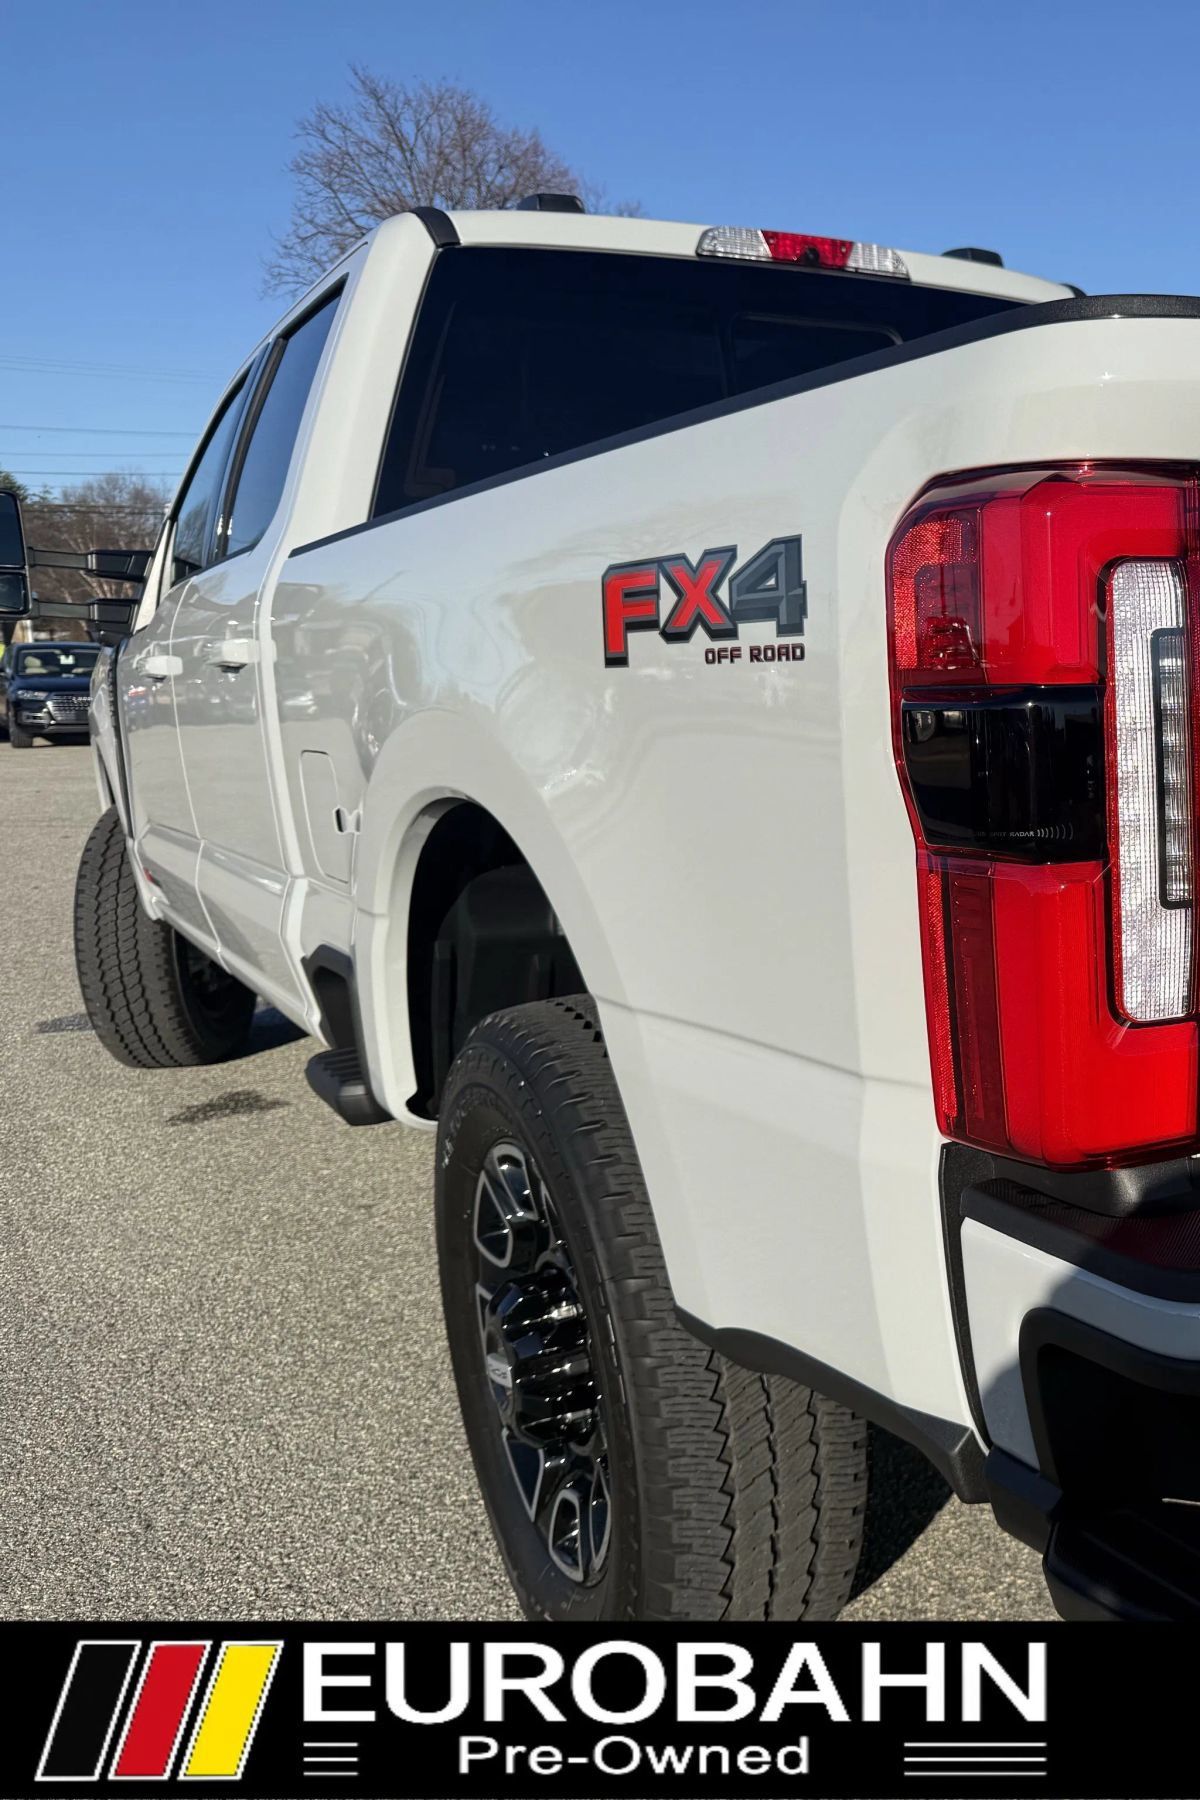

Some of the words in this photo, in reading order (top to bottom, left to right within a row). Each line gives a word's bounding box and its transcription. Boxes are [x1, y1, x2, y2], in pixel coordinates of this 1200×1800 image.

[602, 534, 808, 668] FX4
[704, 646, 742, 664] OFF
[749, 643, 805, 662] ROAD
